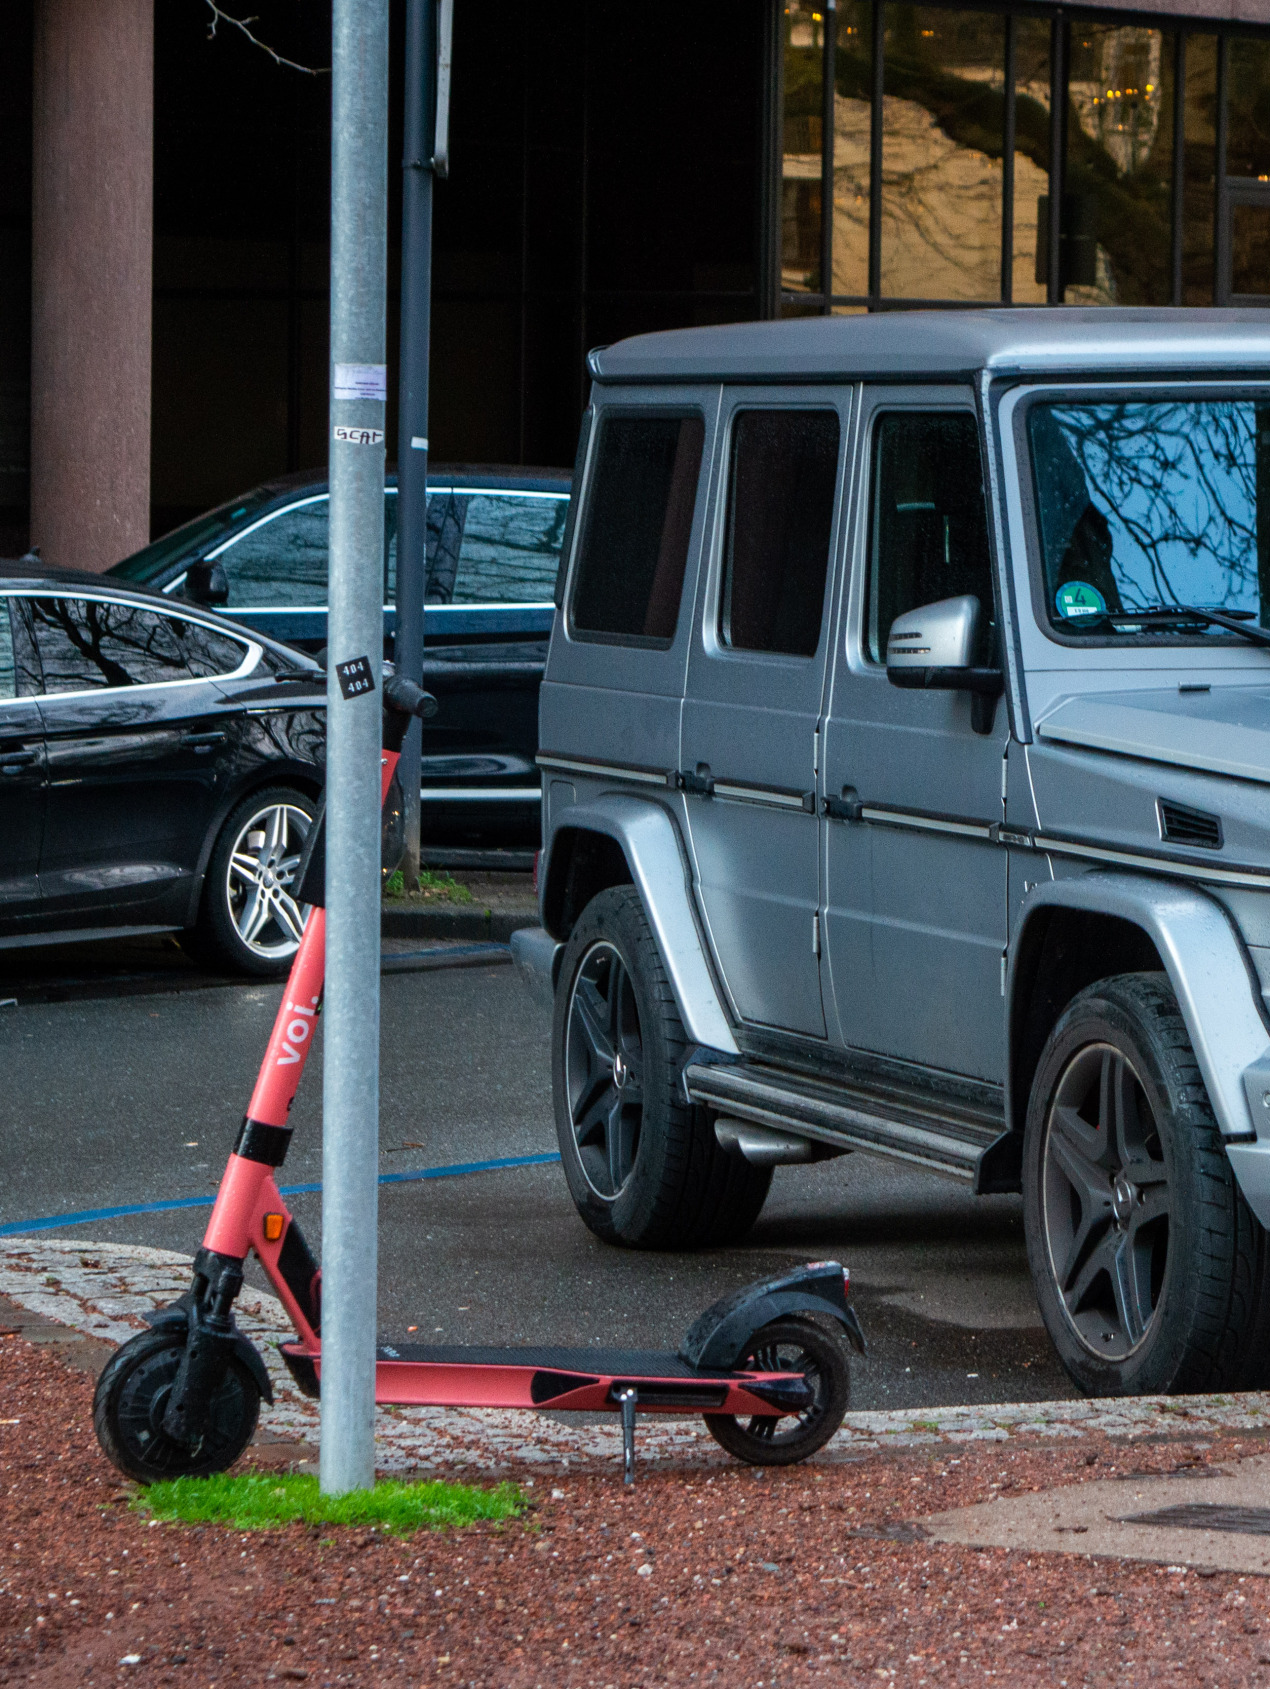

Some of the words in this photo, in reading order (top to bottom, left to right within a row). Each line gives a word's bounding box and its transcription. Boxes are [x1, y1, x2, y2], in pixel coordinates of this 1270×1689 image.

[1075, 588, 1086, 605] 4
[342, 661, 364, 676] 404
[348, 678, 369, 692] 404
[277, 996, 319, 1065] voi.
